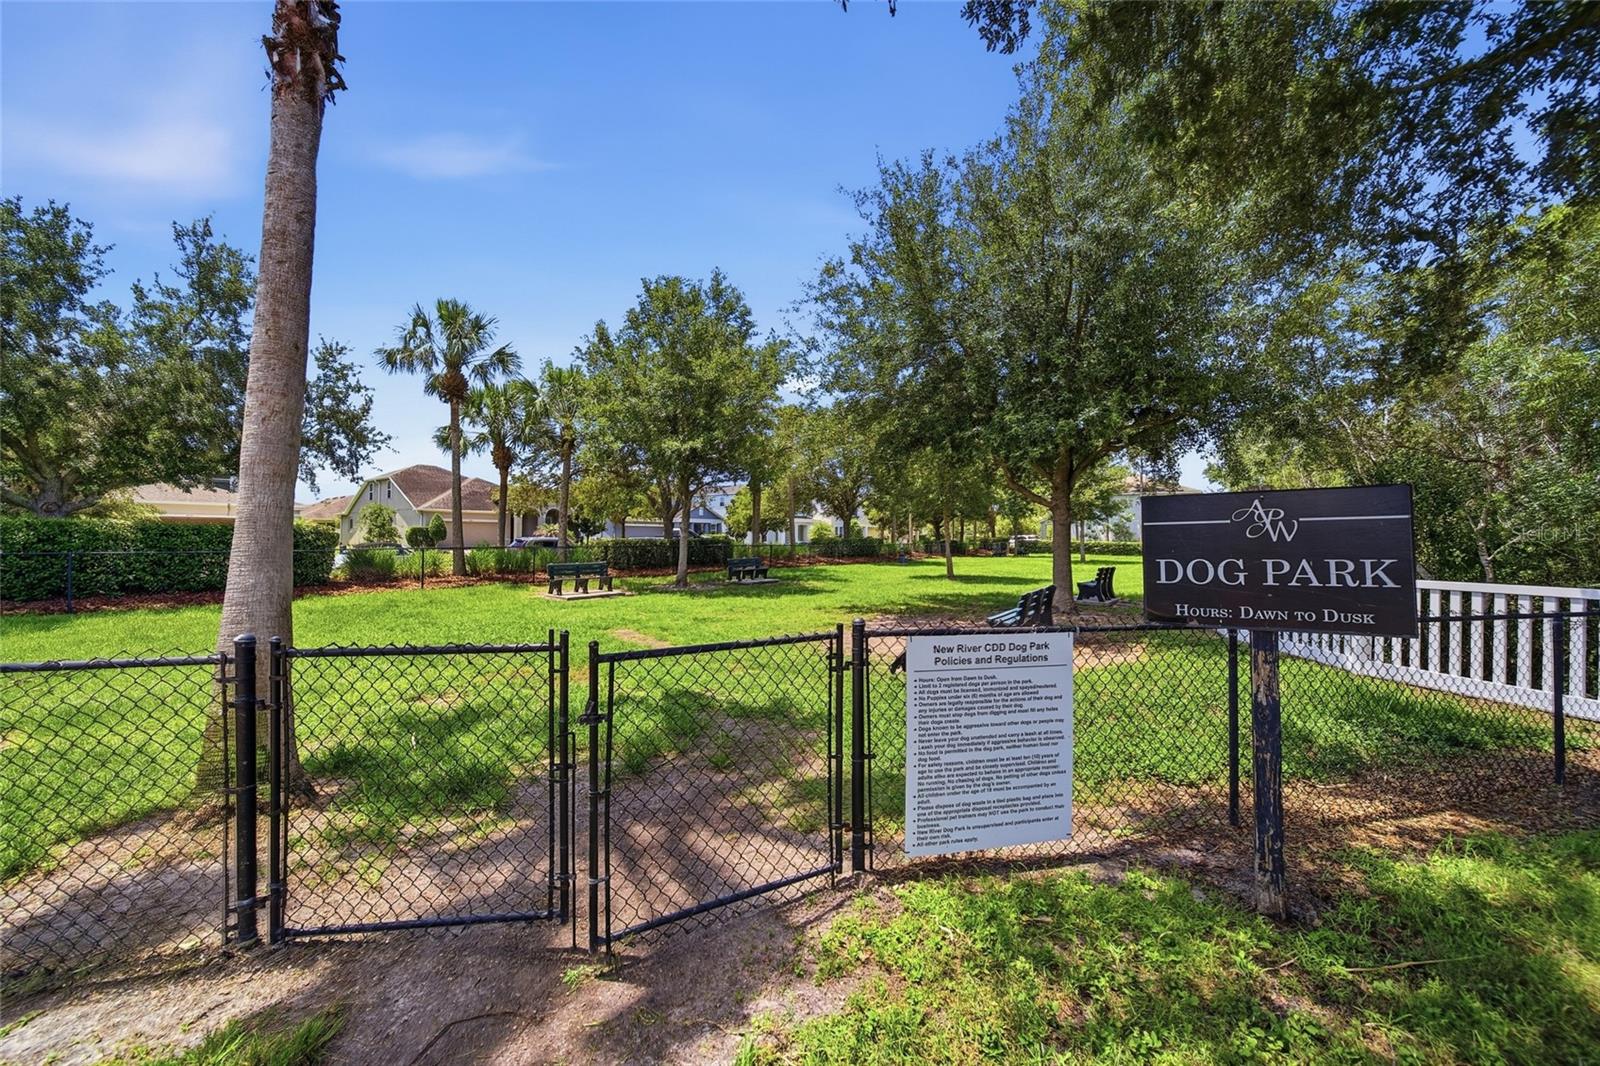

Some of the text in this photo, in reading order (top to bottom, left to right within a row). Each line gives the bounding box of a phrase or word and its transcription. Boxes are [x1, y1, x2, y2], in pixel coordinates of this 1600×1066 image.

[1155, 558, 1402, 588] DOG PARK
[933, 641, 1049, 653] New River CDD Dog Park
[934, 653, 1048, 665] Policies and Regulations
